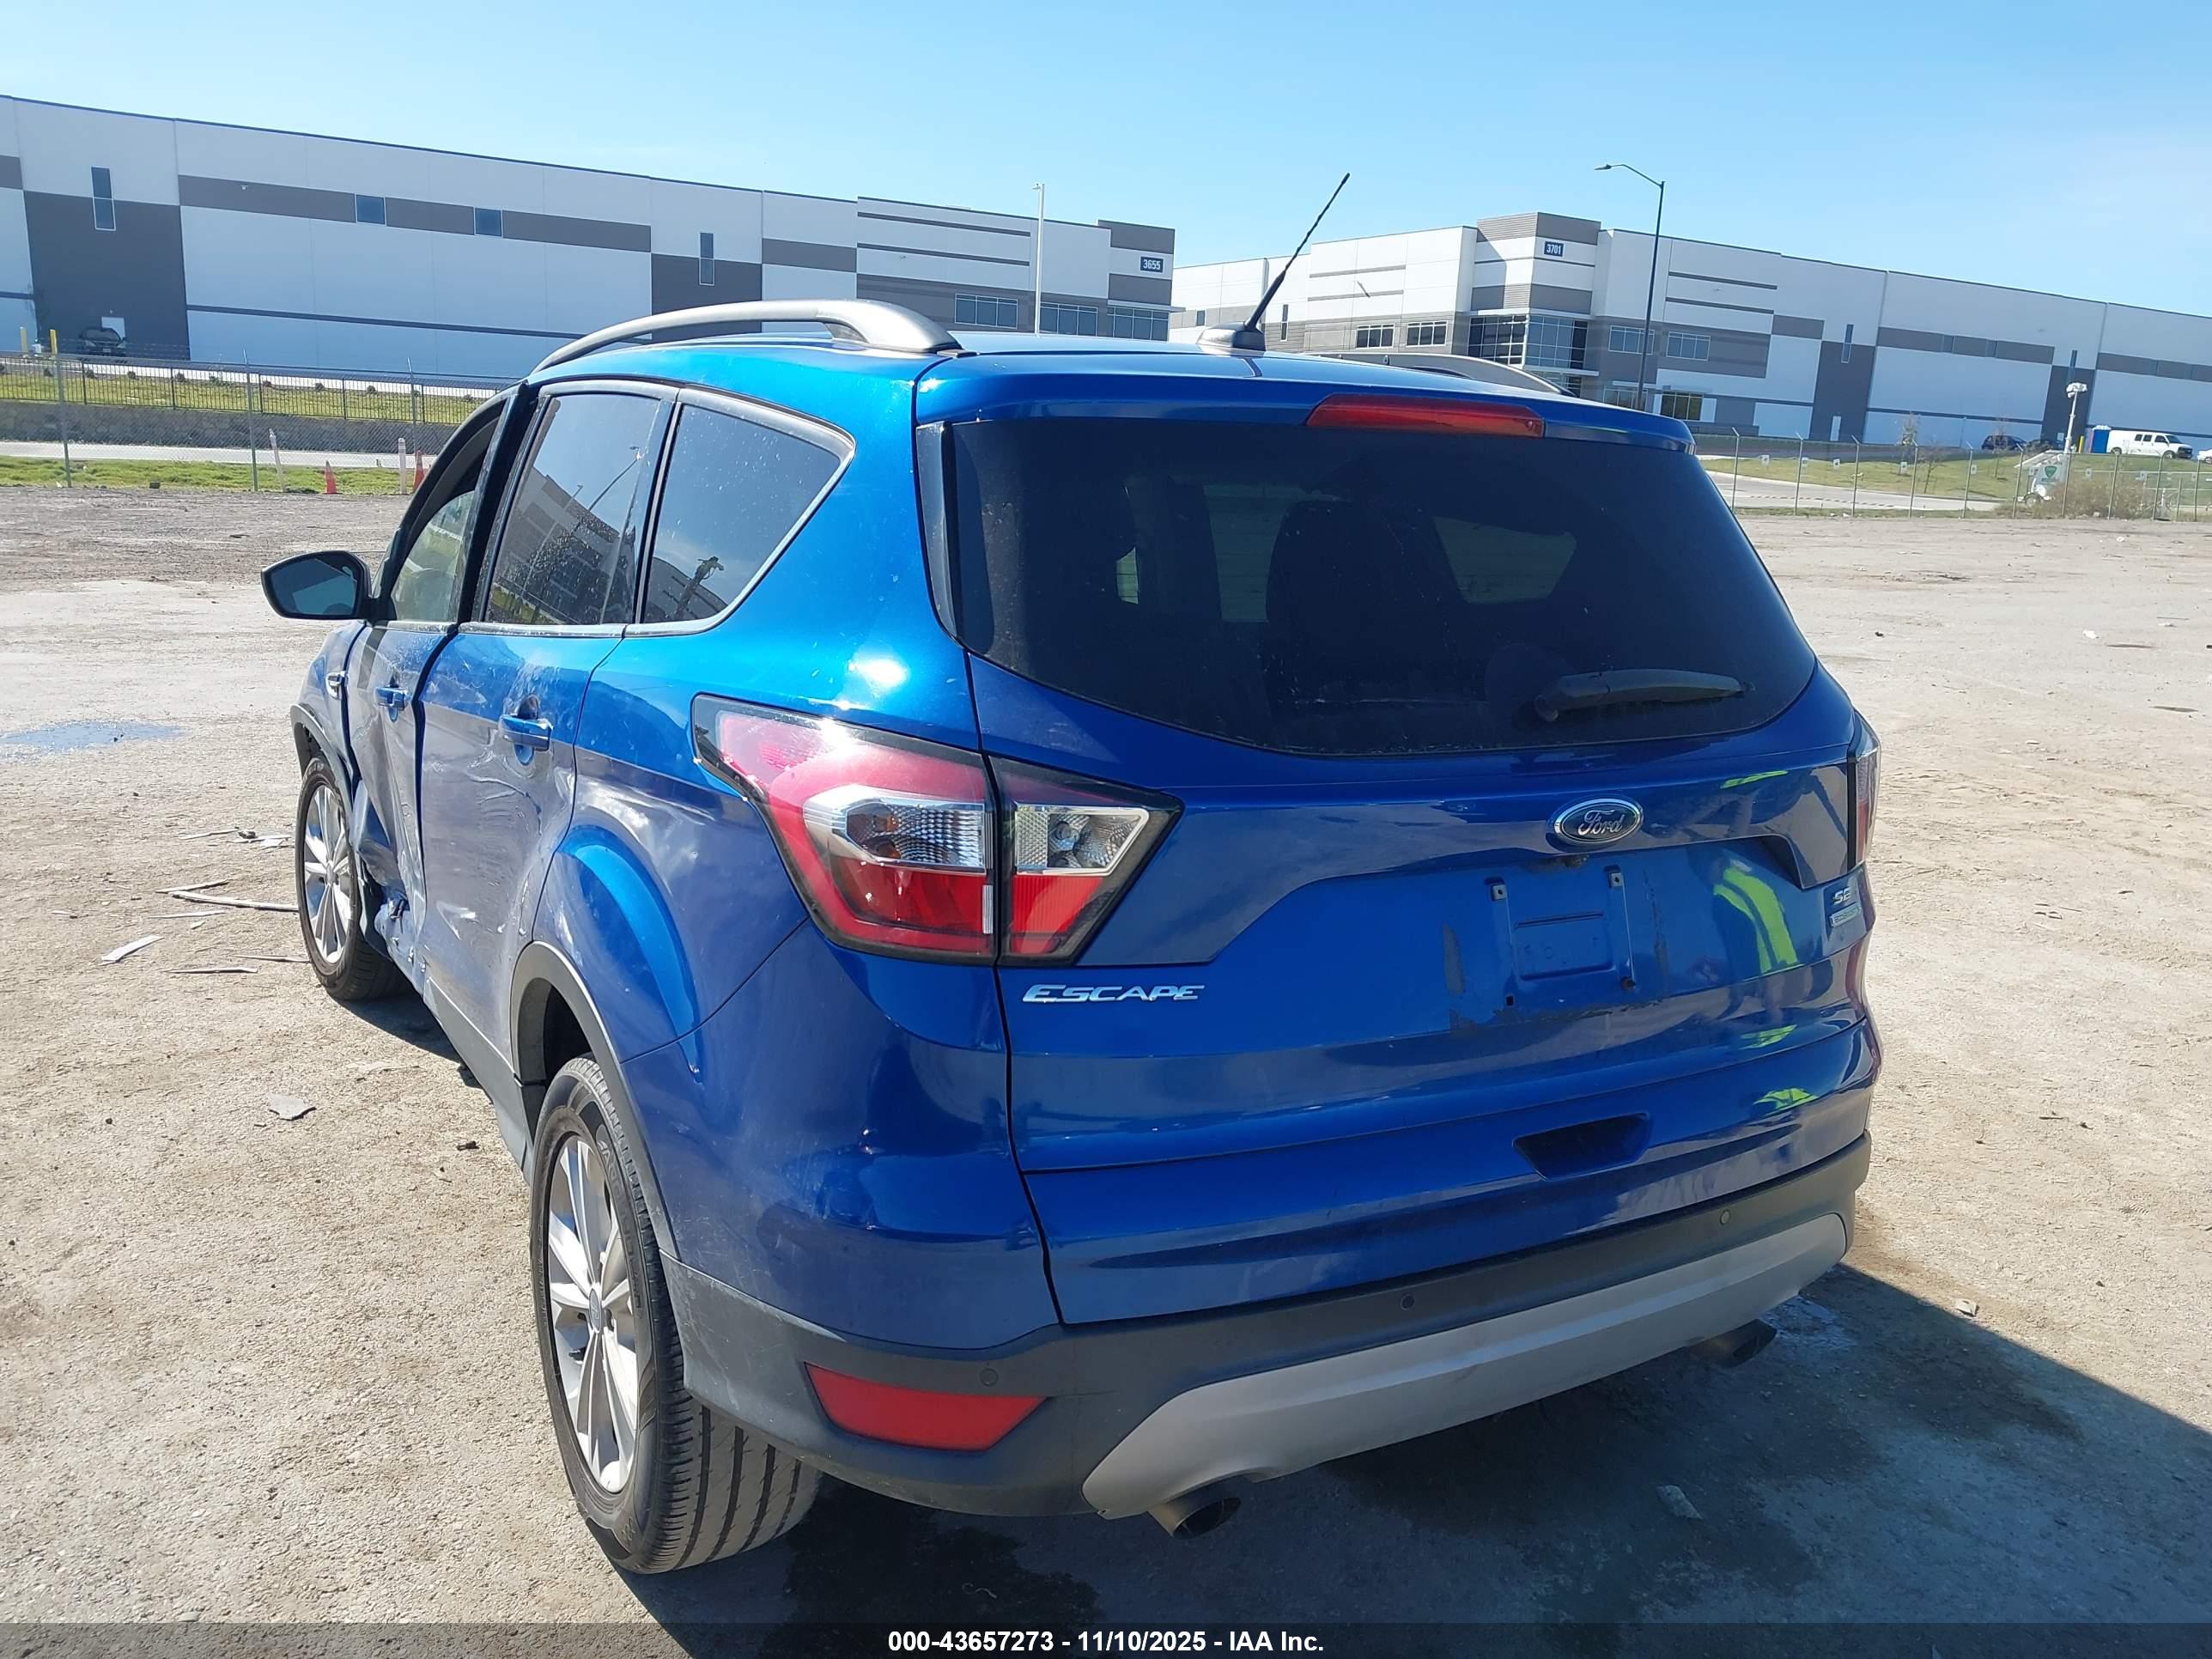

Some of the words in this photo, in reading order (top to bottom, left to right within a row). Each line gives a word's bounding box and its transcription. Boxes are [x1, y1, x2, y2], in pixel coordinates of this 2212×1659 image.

[1546, 243, 1562, 255] 3701
[1143, 258, 1161, 270] 3655
[1577, 809, 1626, 836] Ford
[1832, 886, 1851, 905] SE
[1022, 984, 1205, 1003] ESCAPE
